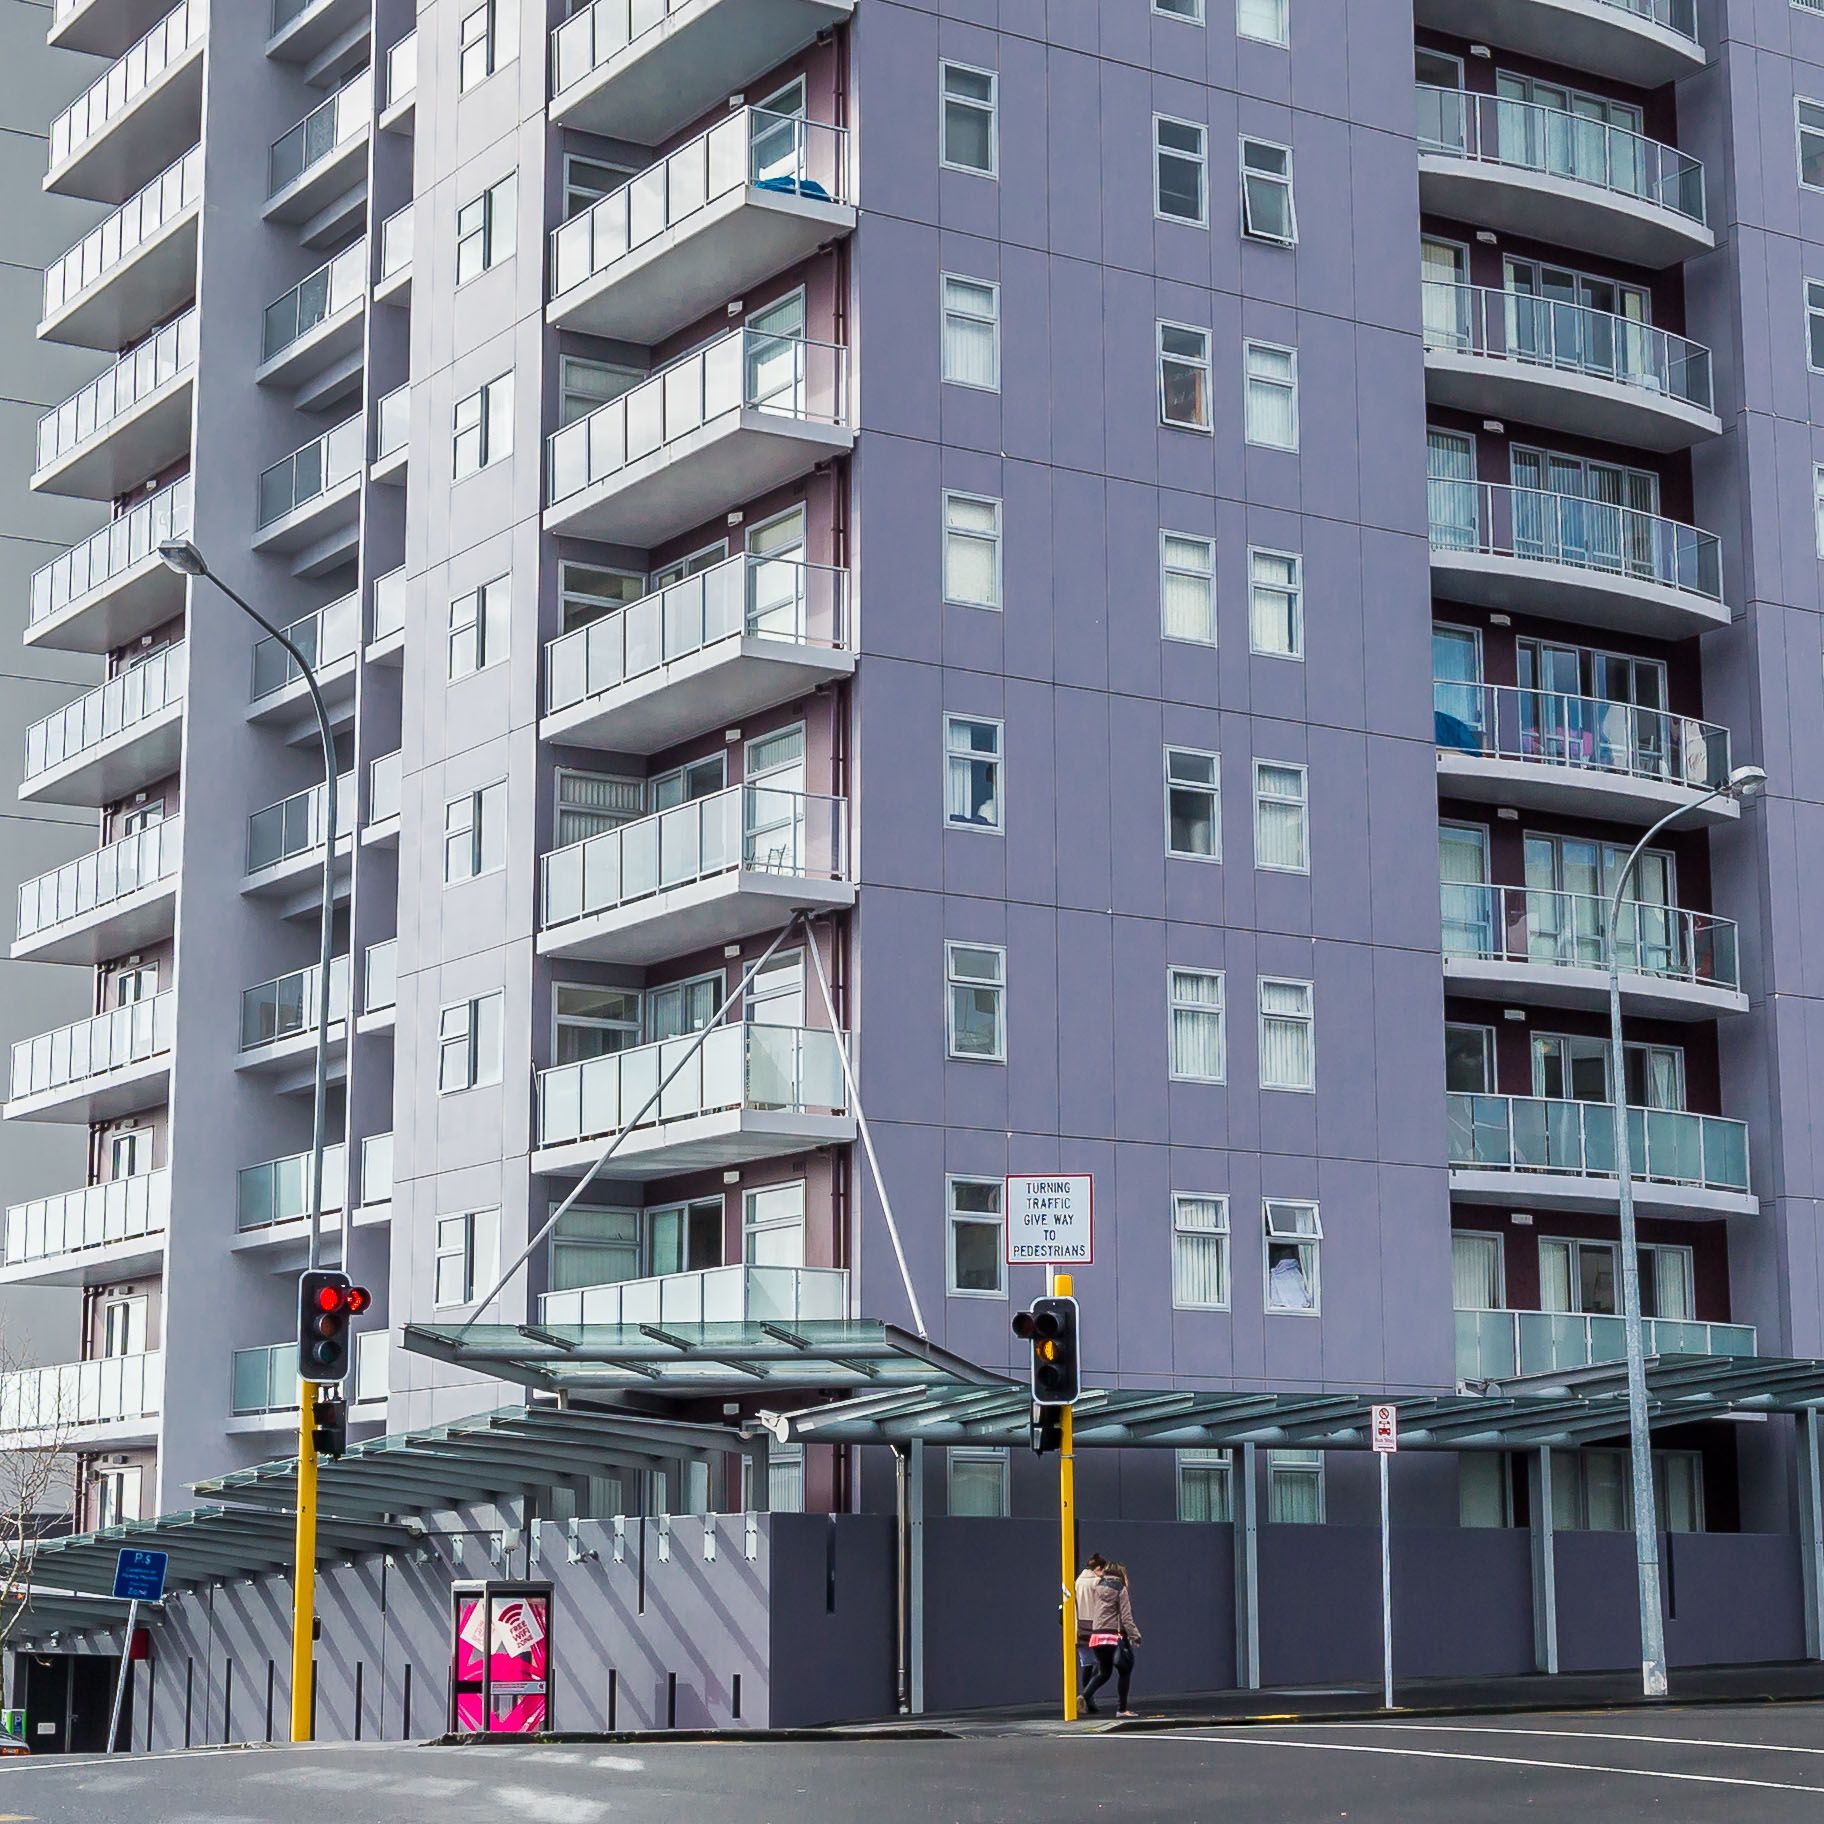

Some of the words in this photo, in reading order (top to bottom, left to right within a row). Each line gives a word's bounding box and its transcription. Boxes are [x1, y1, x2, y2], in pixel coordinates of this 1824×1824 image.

[1026, 1182, 1071, 1194] TURNING
[1026, 1198, 1071, 1210] TRAFFIC
[1023, 1214, 1048, 1226] GIVE
[1054, 1214, 1074, 1226] WAY
[1043, 1229, 1056, 1241] TO
[1013, 1245, 1086, 1257] PEDESTRIANS
[510, 1620, 527, 1634] FREE
